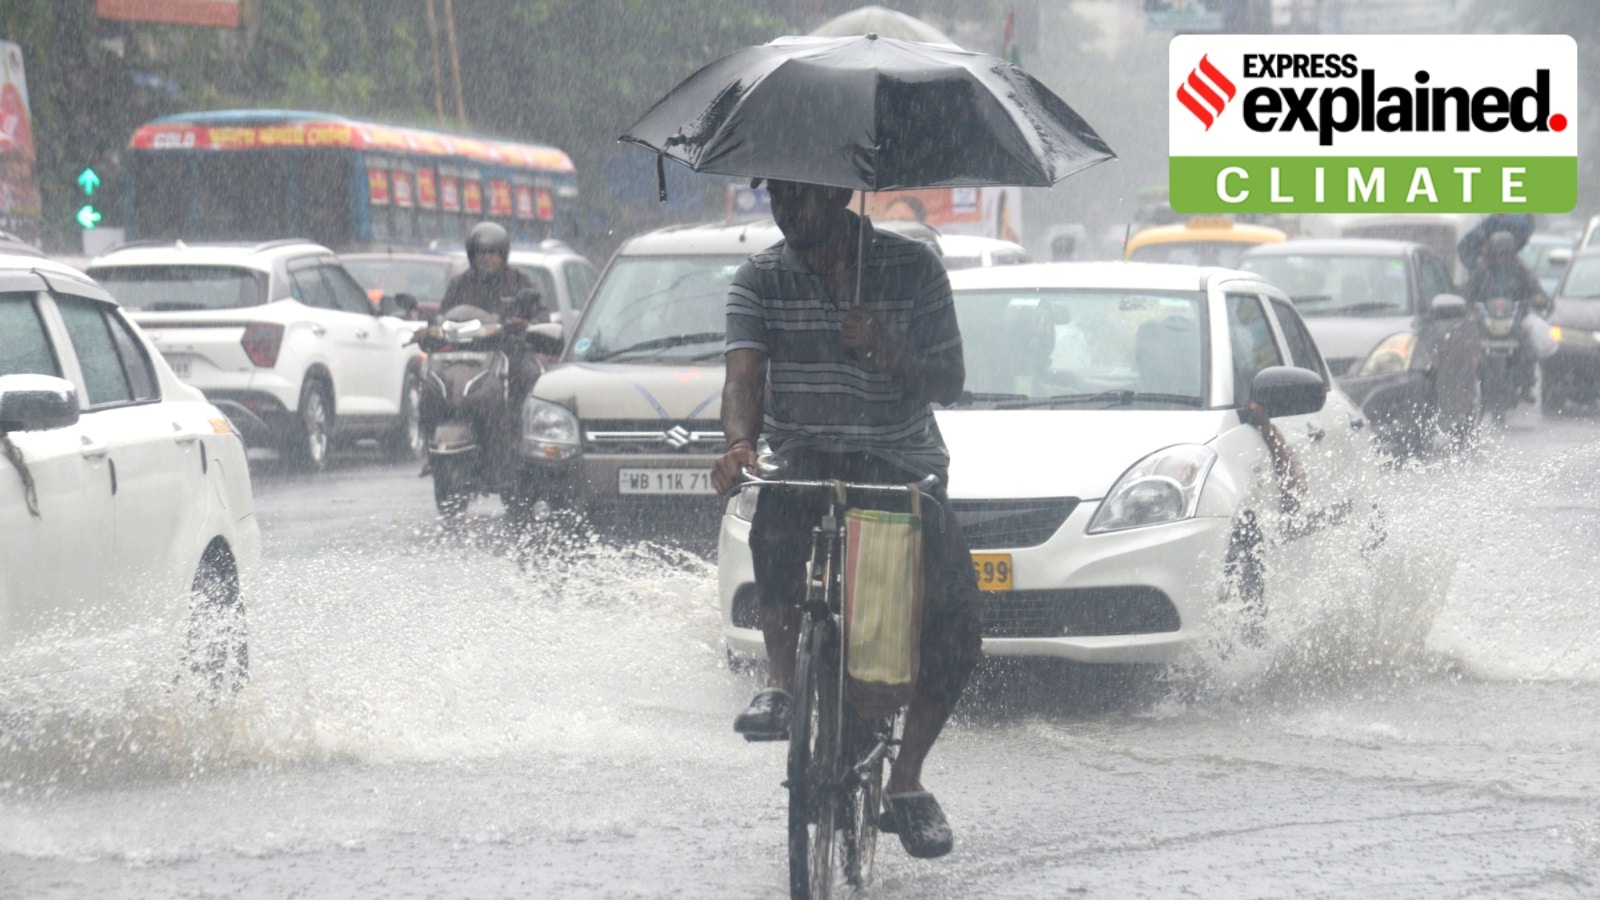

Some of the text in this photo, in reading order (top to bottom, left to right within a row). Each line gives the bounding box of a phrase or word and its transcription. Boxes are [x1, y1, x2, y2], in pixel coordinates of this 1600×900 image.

[630, 473, 649, 489] WB
[657, 473, 684, 489] 11K
[690, 473, 716, 489] 71
